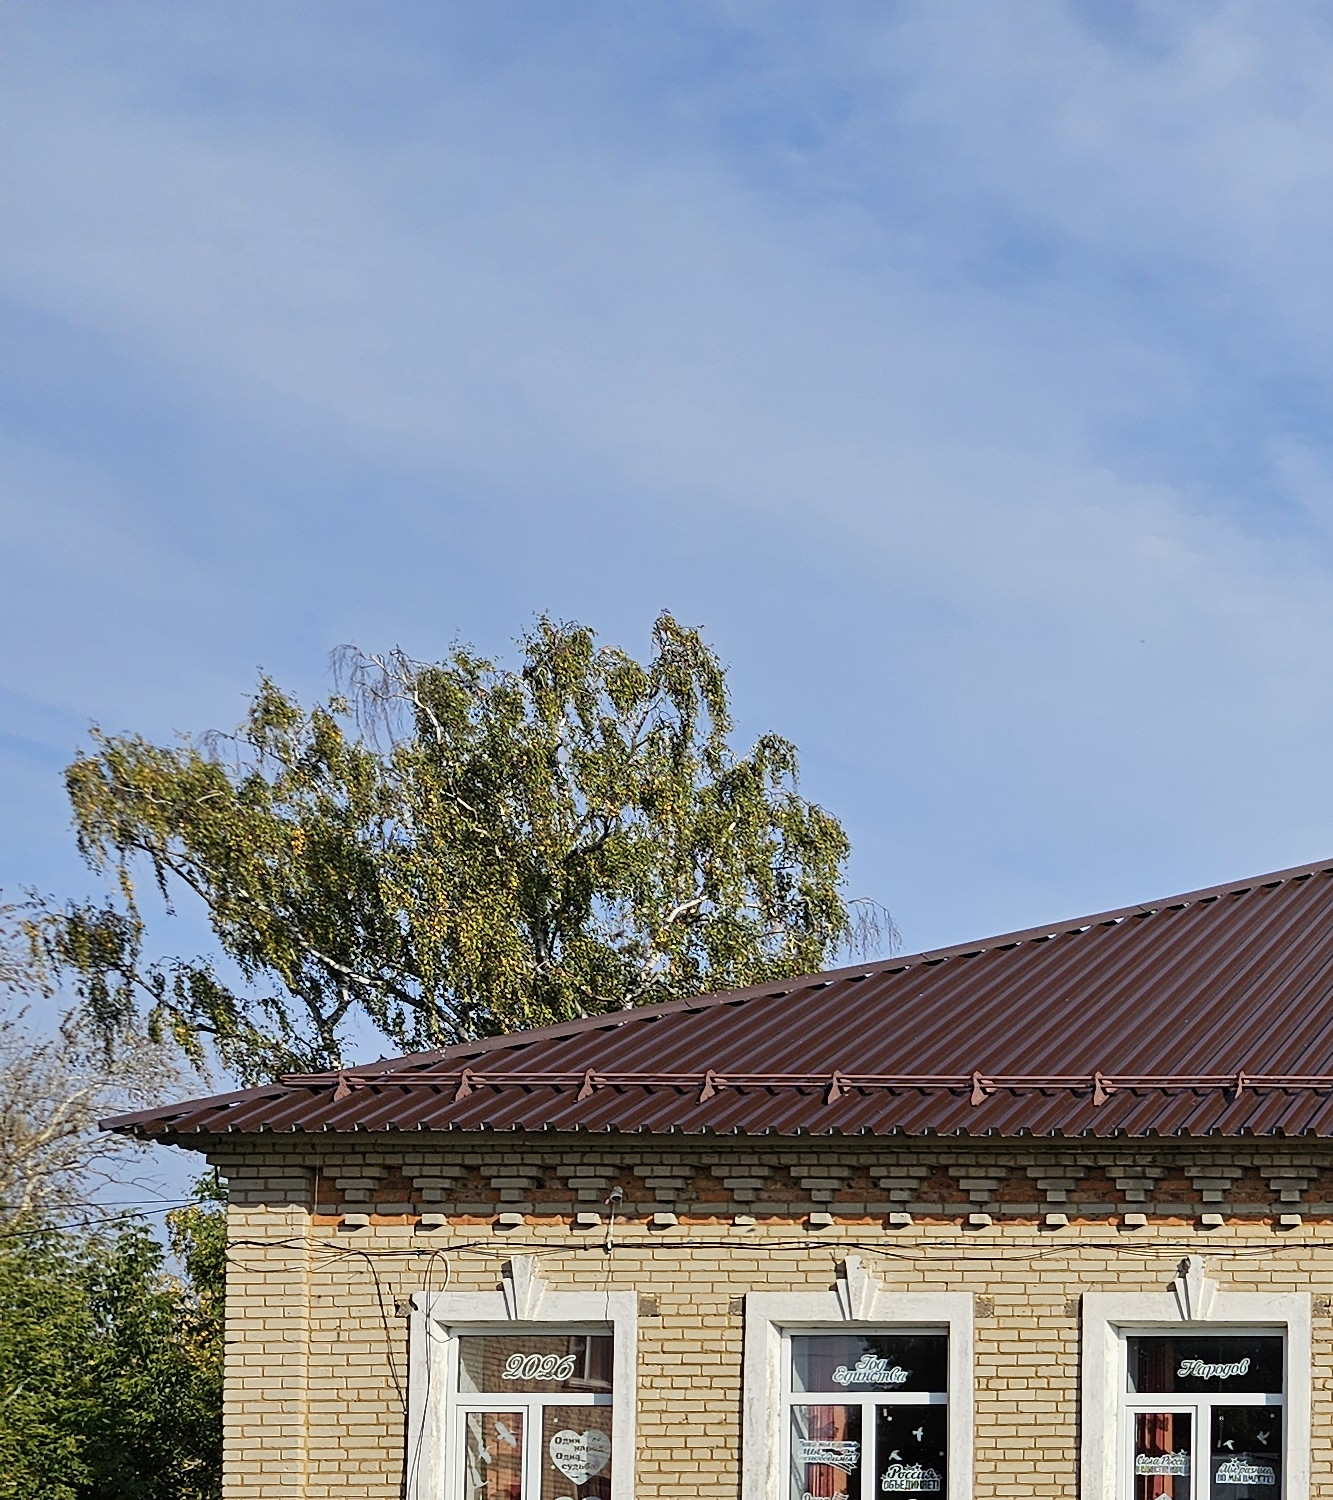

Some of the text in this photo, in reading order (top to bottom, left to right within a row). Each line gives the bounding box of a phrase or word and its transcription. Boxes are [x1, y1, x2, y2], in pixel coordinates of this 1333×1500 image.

[503, 1354, 576, 1380] 2026
[855, 1354, 888, 1372] Год
[1177, 1358, 1250, 1380] Народов
[833, 1366, 908, 1386] Единства
[886, 1464, 938, 1480] Россия
[883, 1480, 939, 1490] ОБЪЕДИНЯЕТ!
